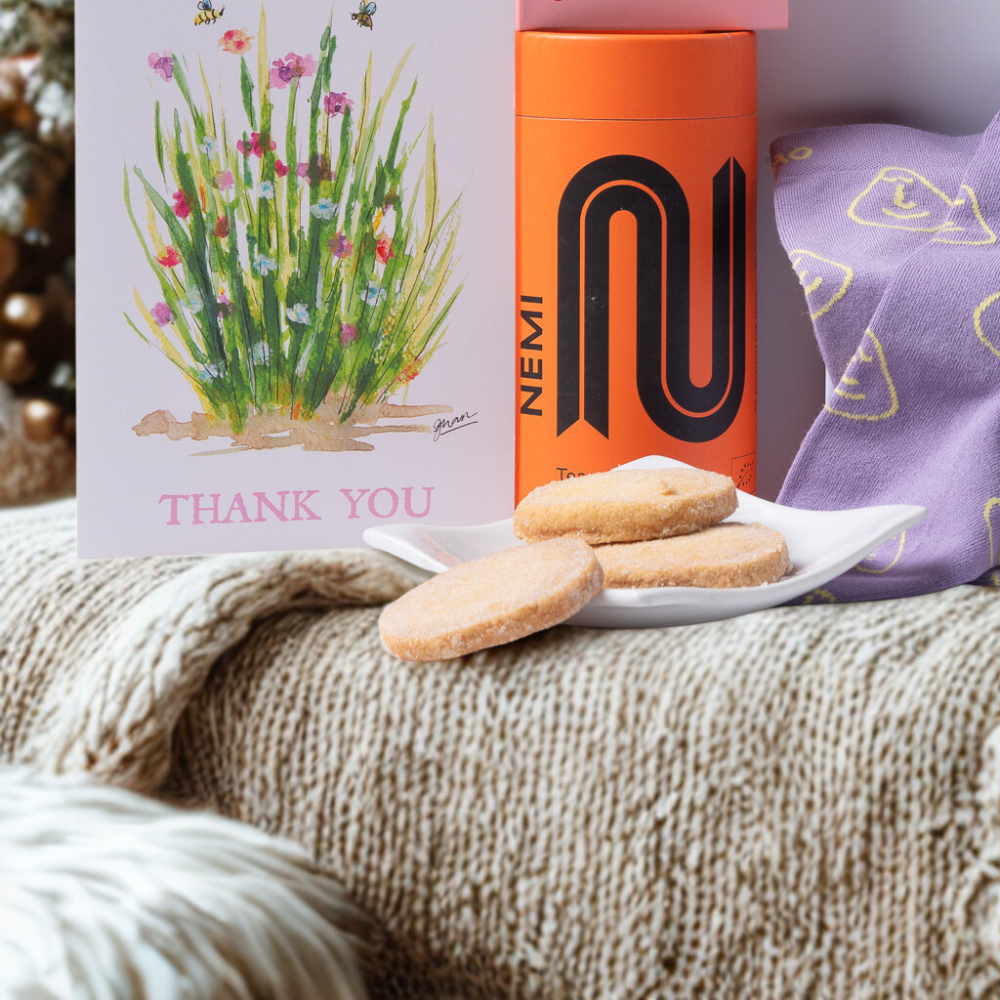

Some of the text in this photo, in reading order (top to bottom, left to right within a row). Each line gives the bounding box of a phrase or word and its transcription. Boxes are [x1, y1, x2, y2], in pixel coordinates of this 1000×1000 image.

[521, 294, 543, 417] NEMI
[159, 486, 437, 526] THANK YOU
